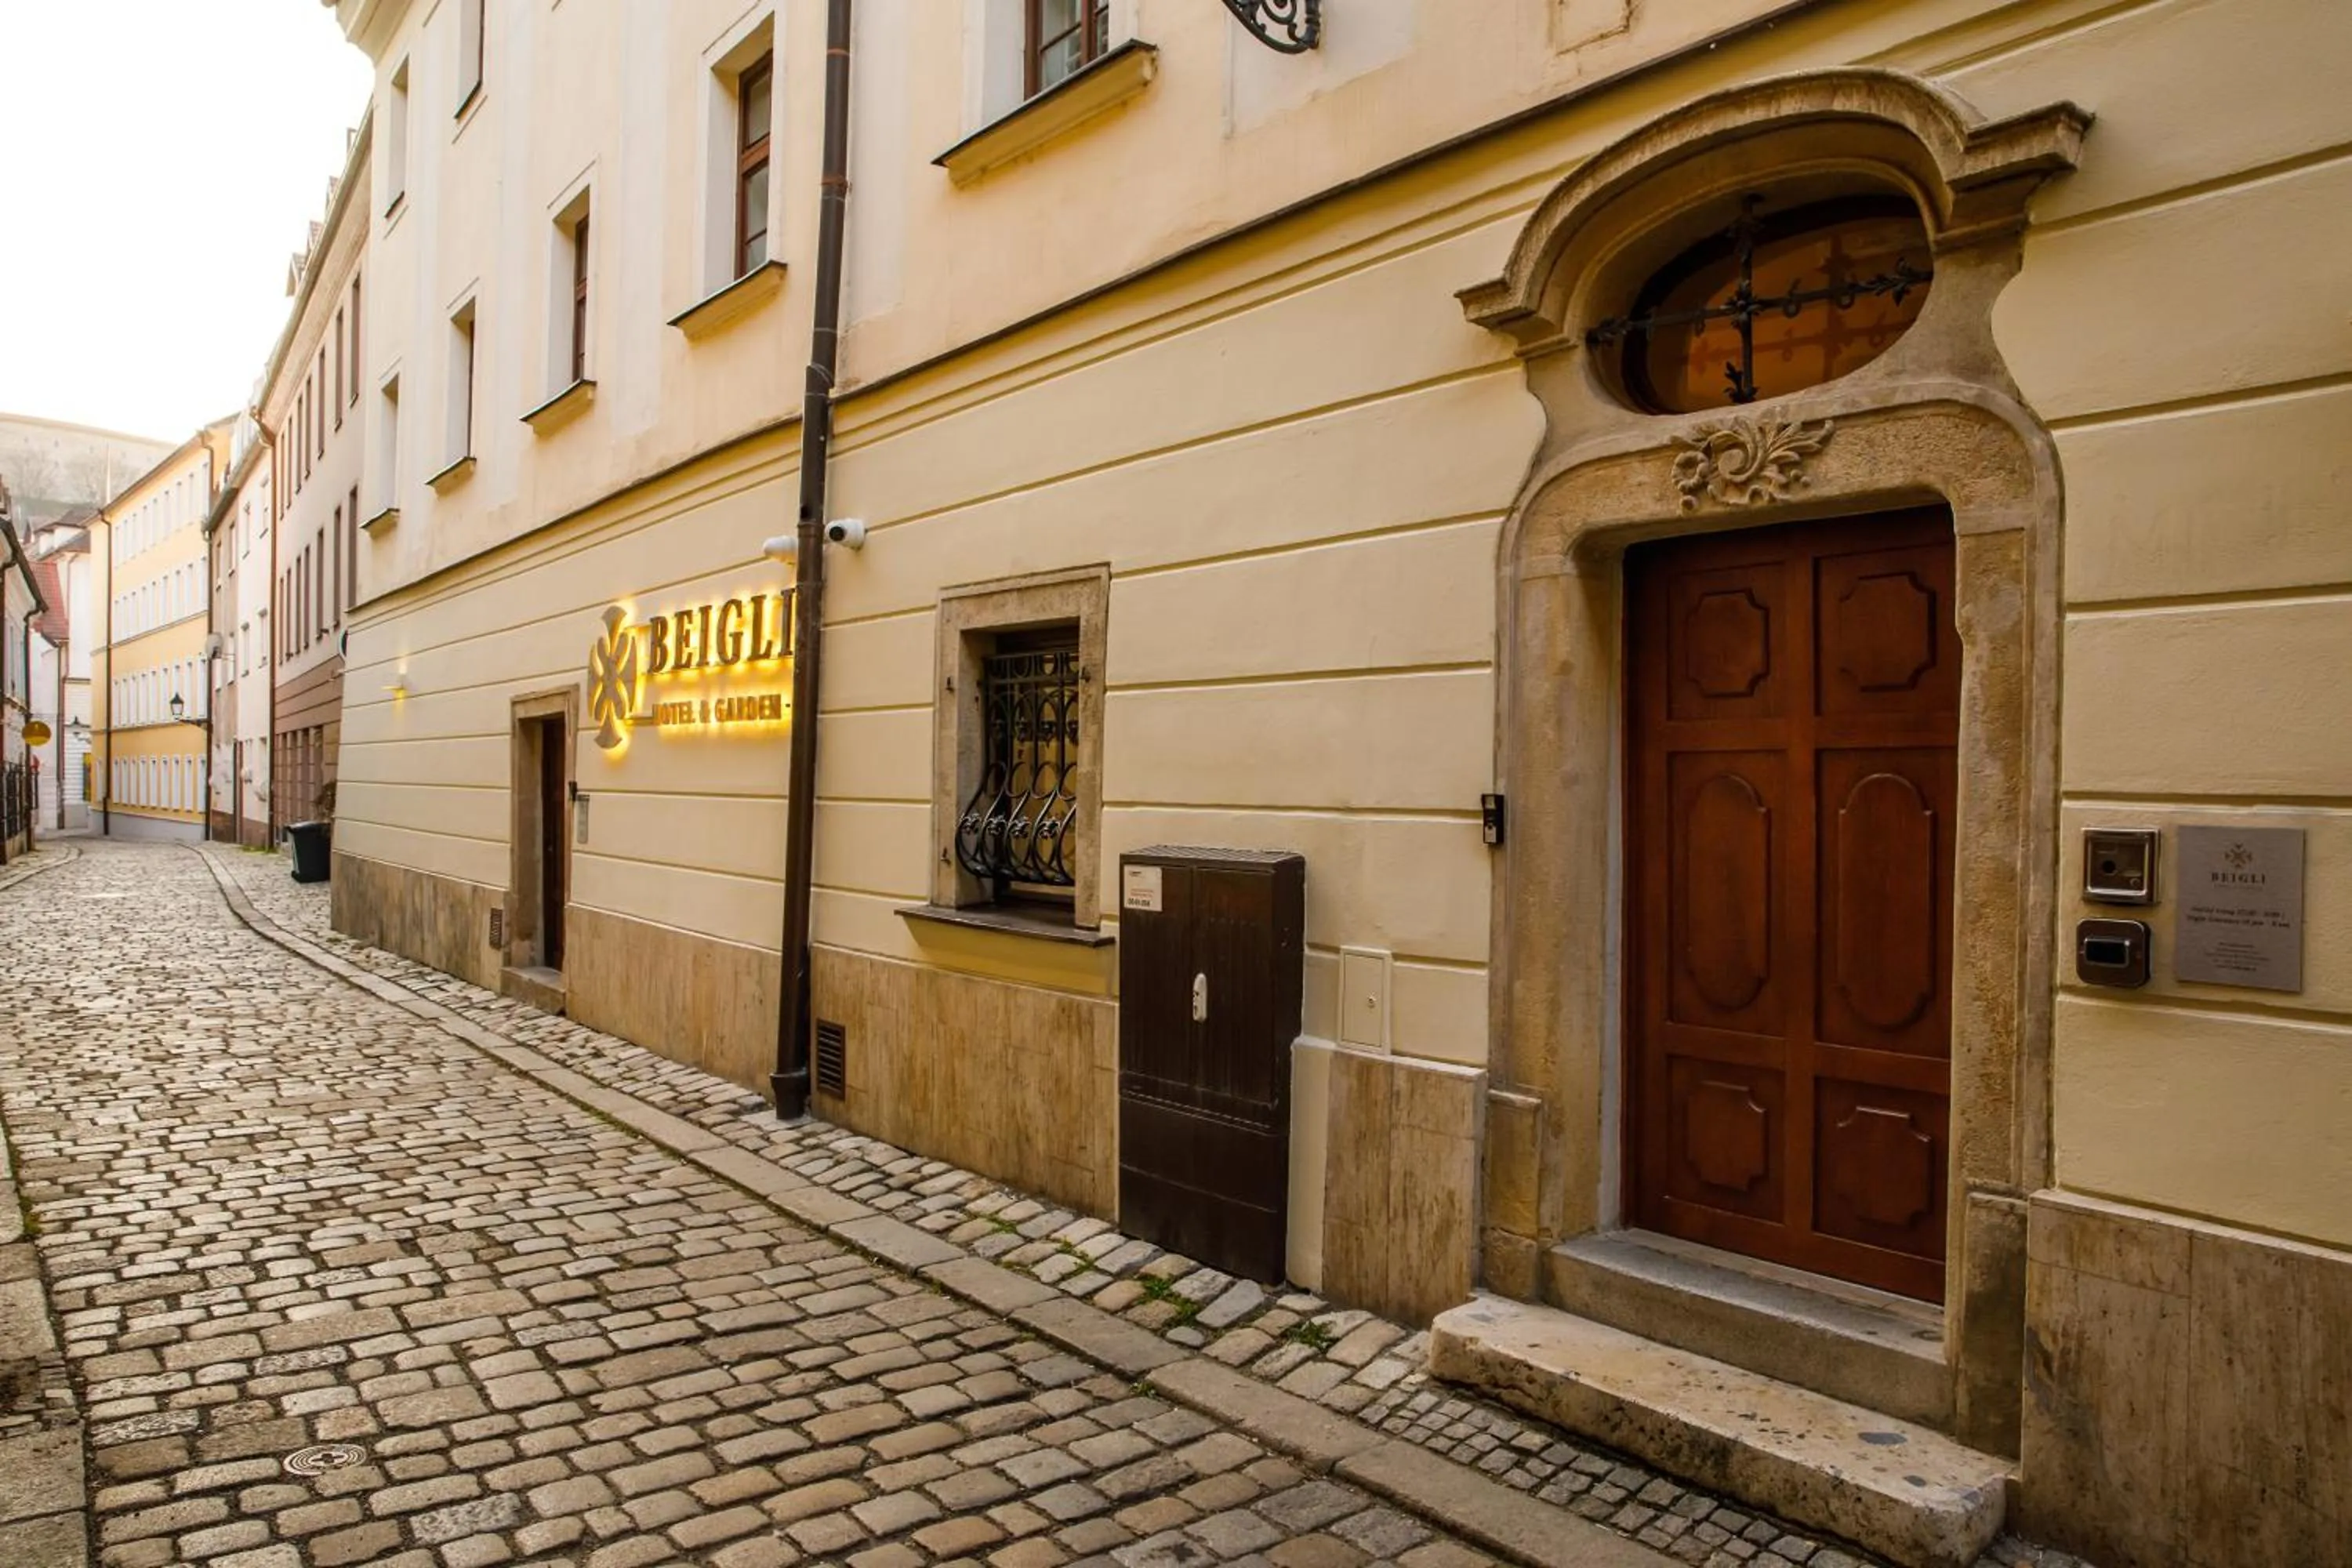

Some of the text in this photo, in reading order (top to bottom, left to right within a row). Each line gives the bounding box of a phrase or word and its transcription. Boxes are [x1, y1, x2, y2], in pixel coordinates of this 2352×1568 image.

[647, 587, 796, 674] BEIGLI
[652, 700, 695, 726] HOTEL
[714, 694, 782, 723] GARDEN
[2211, 872, 2266, 885] BEIGLI
